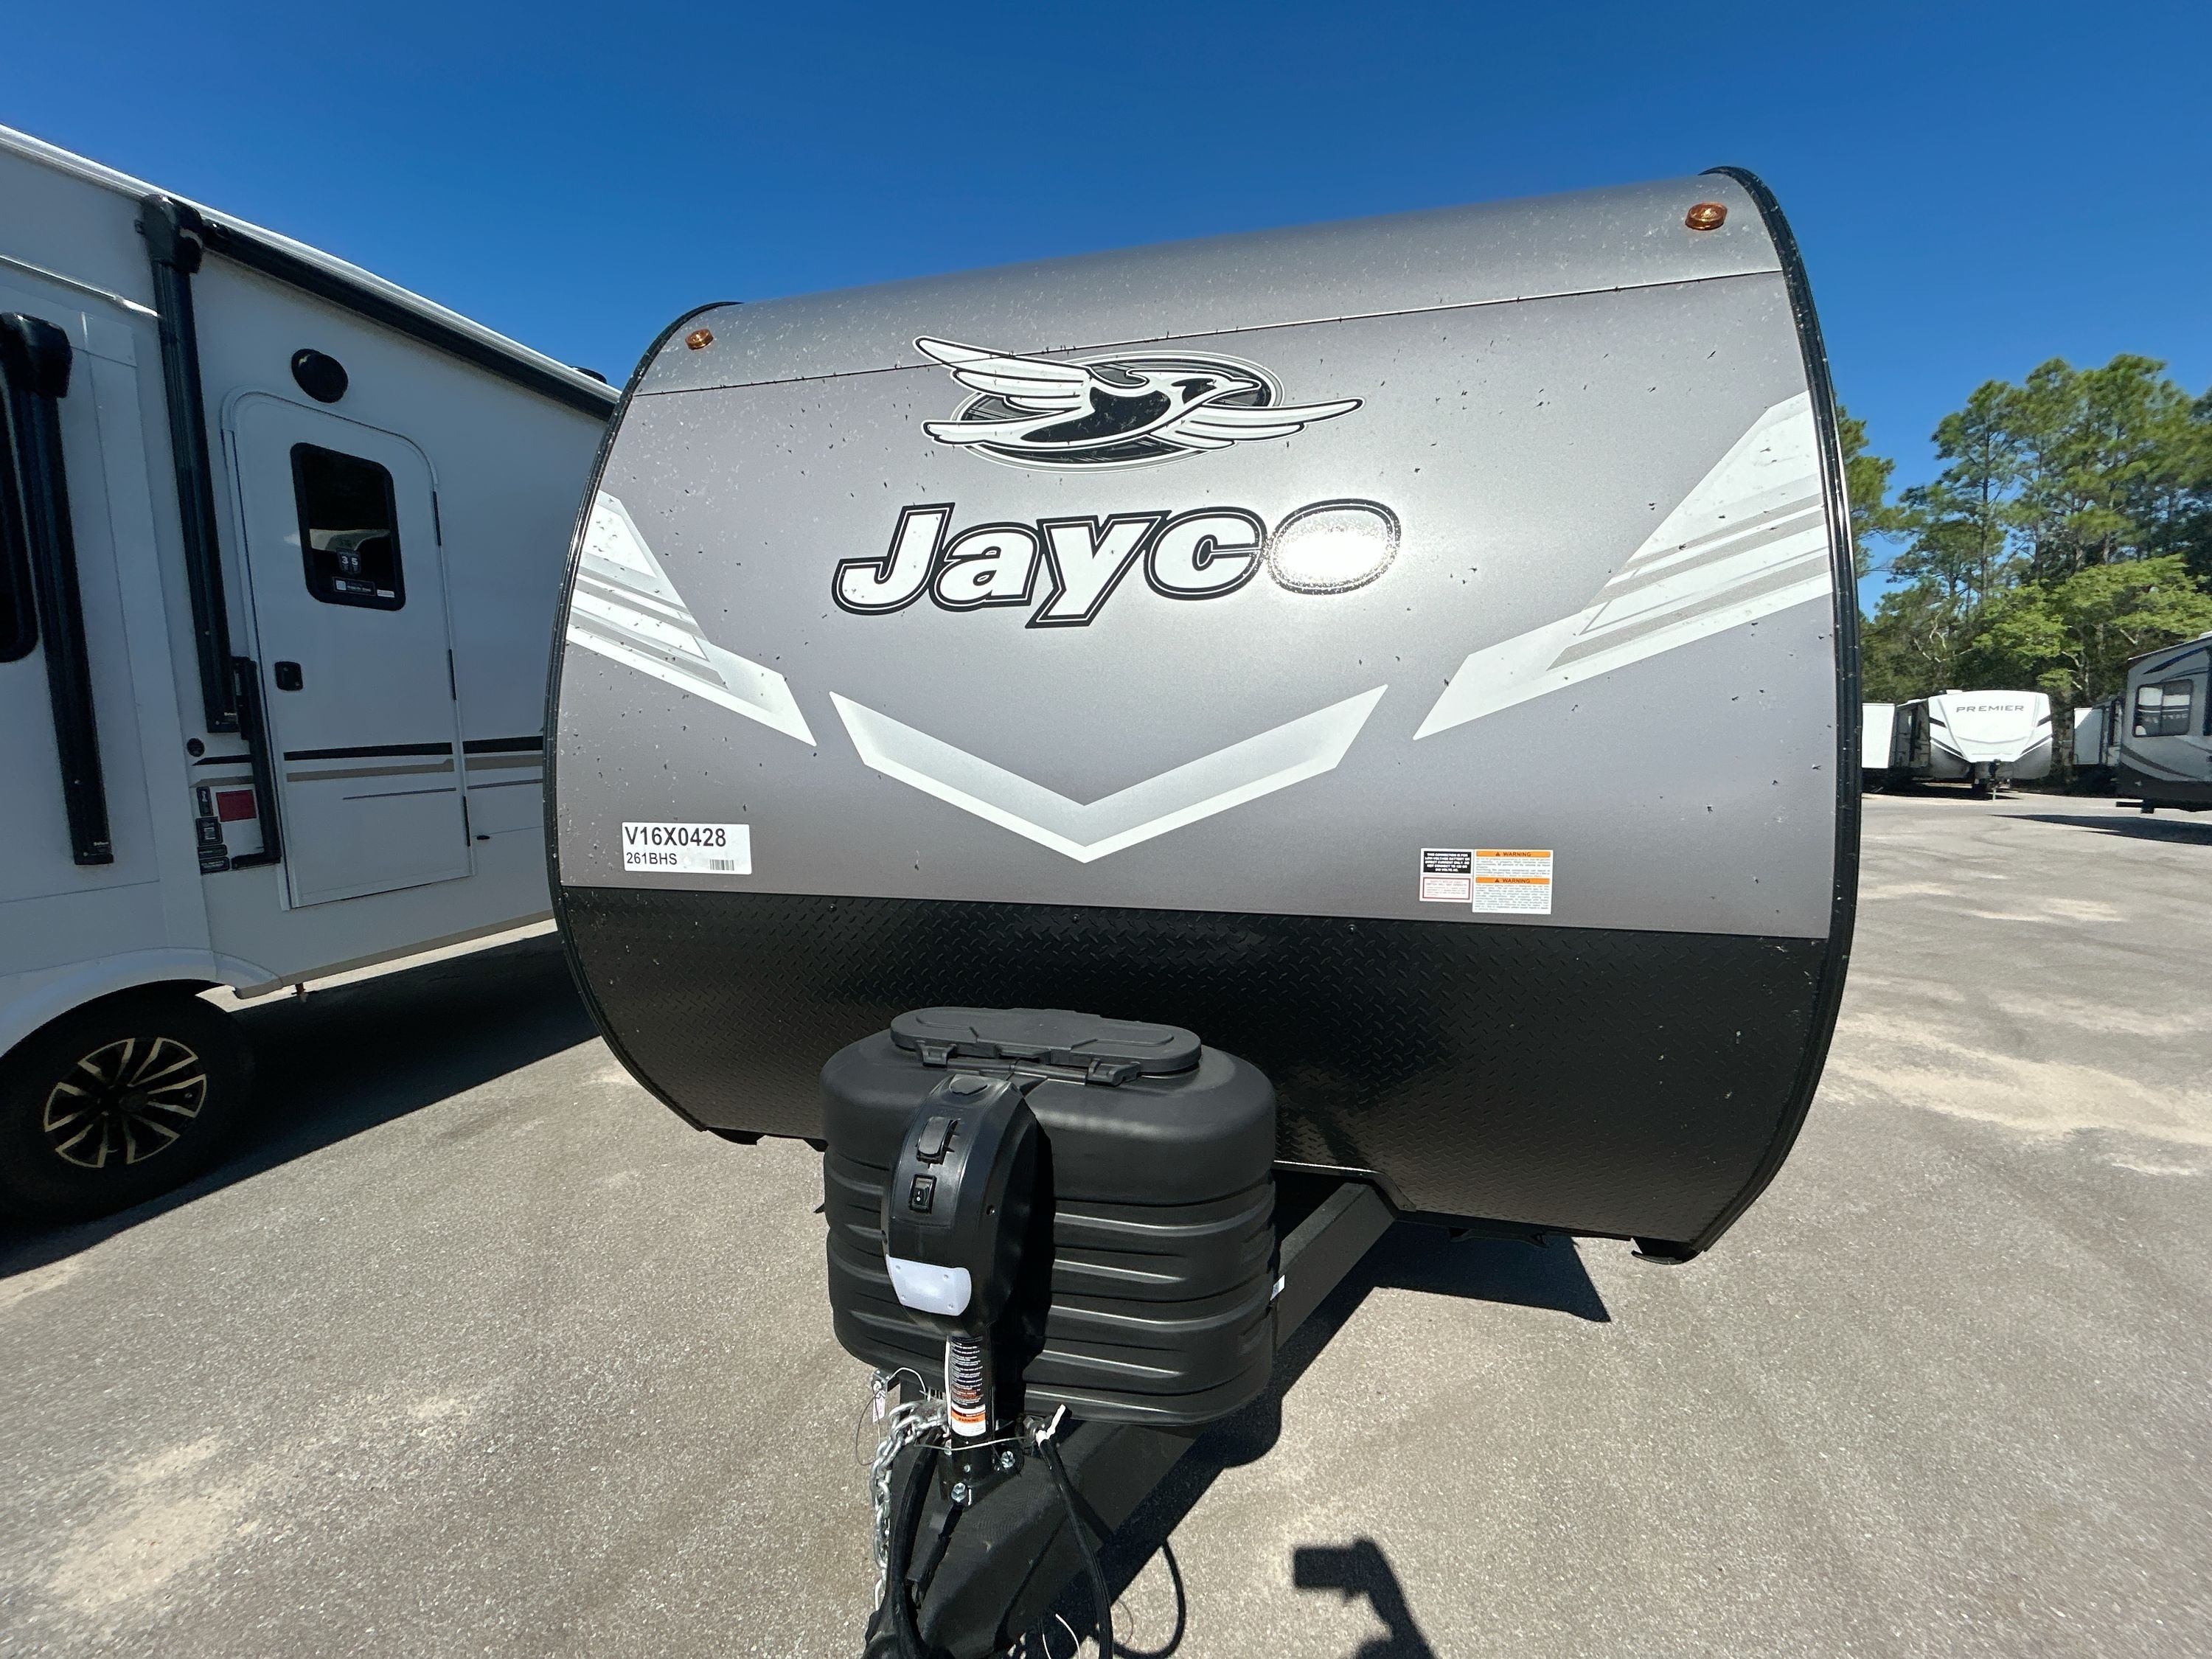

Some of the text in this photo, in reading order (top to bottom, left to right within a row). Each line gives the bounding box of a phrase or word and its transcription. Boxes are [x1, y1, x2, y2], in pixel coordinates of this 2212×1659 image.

[832, 498, 1401, 629] Jayco
[625, 826, 726, 847] V16X0428
[626, 852, 678, 865] 261BHS
